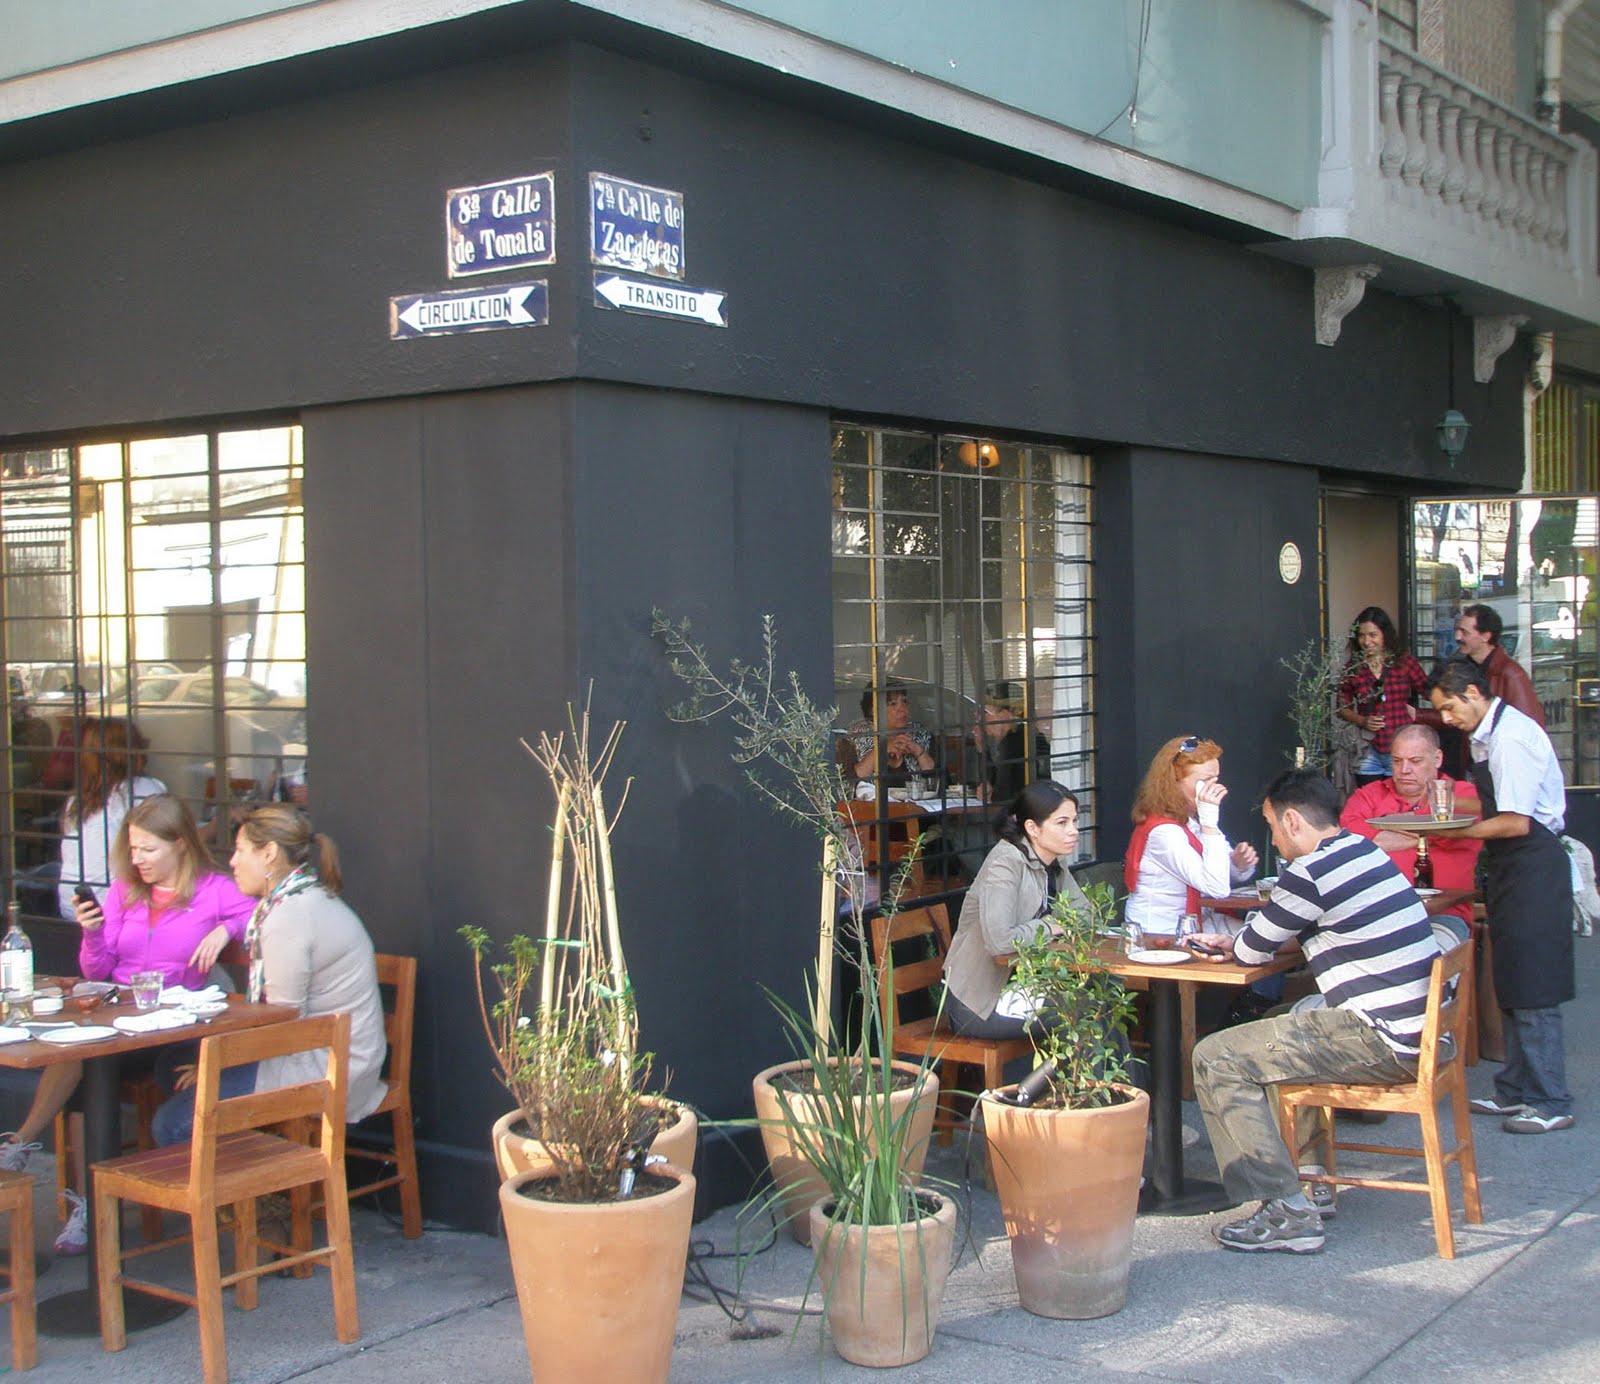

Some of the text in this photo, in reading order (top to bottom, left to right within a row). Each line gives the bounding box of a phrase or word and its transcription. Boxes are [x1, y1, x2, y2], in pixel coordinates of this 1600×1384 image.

[492, 184, 541, 218] Calle
[664, 198, 680, 228] de
[455, 221, 546, 264] de Tonalá
[418, 296, 512, 325] CIRCULACION
[626, 286, 697, 312] TRANSITO
